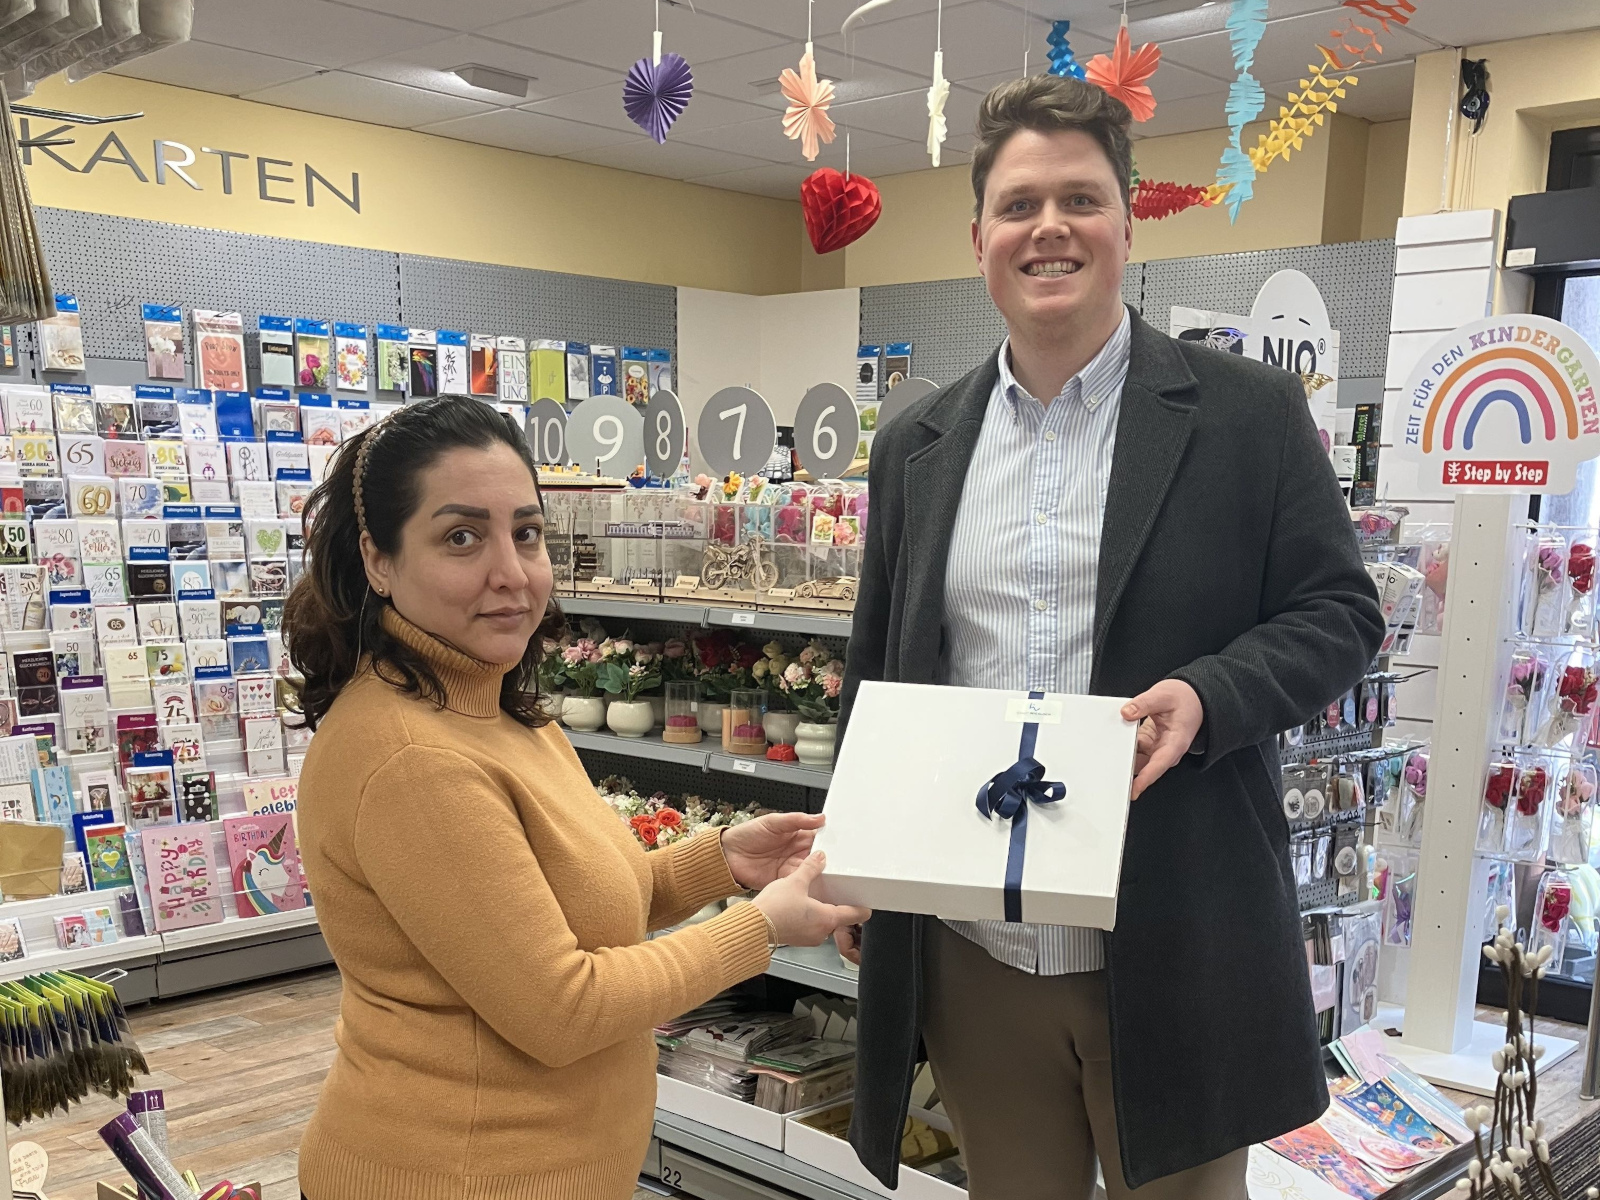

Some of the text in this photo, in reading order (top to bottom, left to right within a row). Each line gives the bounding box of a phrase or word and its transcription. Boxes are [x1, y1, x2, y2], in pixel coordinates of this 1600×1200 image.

[19, 117, 361, 214] KARTEN
[1406, 326, 1600, 445] ZEIT FÜR DEN KINDERGARTEN
[531, 416, 564, 465] 10
[593, 414, 624, 462] 9
[655, 409, 672, 461] 8
[718, 403, 748, 461] 7
[812, 405, 839, 460] 6
[23, 441, 48, 461] 80
[66, 441, 94, 465] 65
[156, 446, 178, 465] 80
[1464, 463, 1543, 483] Step by Step
[77, 485, 111, 515] 60
[129, 485, 147, 502] 70
[8, 526, 25, 542] 50
[104, 567, 120, 581] 65
[66, 642, 79, 653] 50
[127, 652, 138, 661] 65
[152, 650, 169, 662] 75
[219, 685, 235, 700] 95
[172, 742, 199, 759] 75
[233, 830, 268, 843] BIRTHDAY
[662, 1166, 682, 1189] 22
